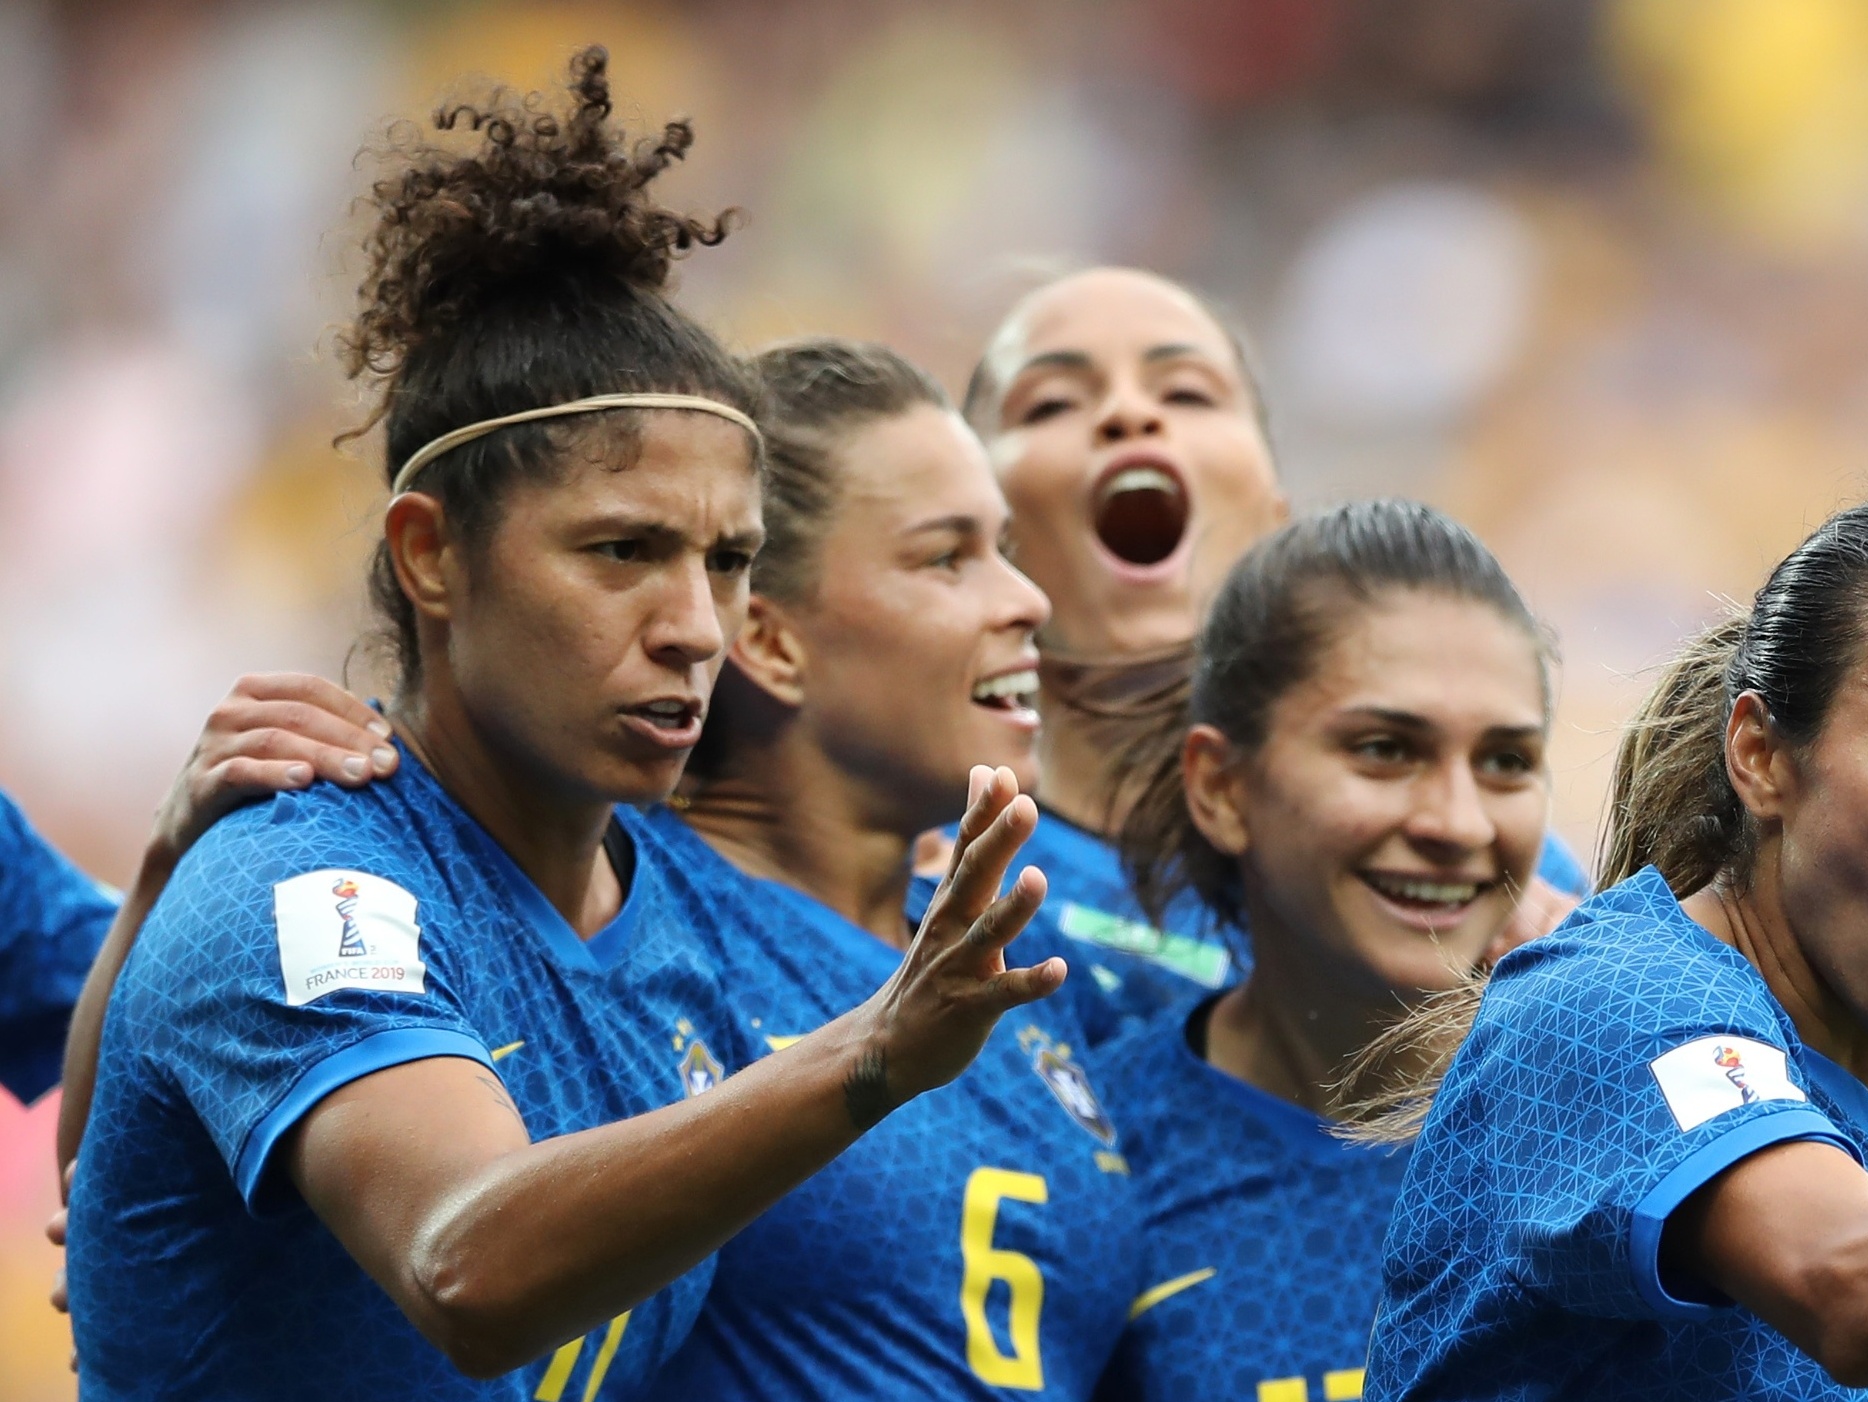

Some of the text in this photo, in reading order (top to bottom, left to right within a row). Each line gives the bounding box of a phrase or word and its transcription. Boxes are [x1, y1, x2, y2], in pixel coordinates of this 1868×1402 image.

[305, 966, 405, 990] FRANCE 2019
[960, 1165, 1048, 1391] 6
